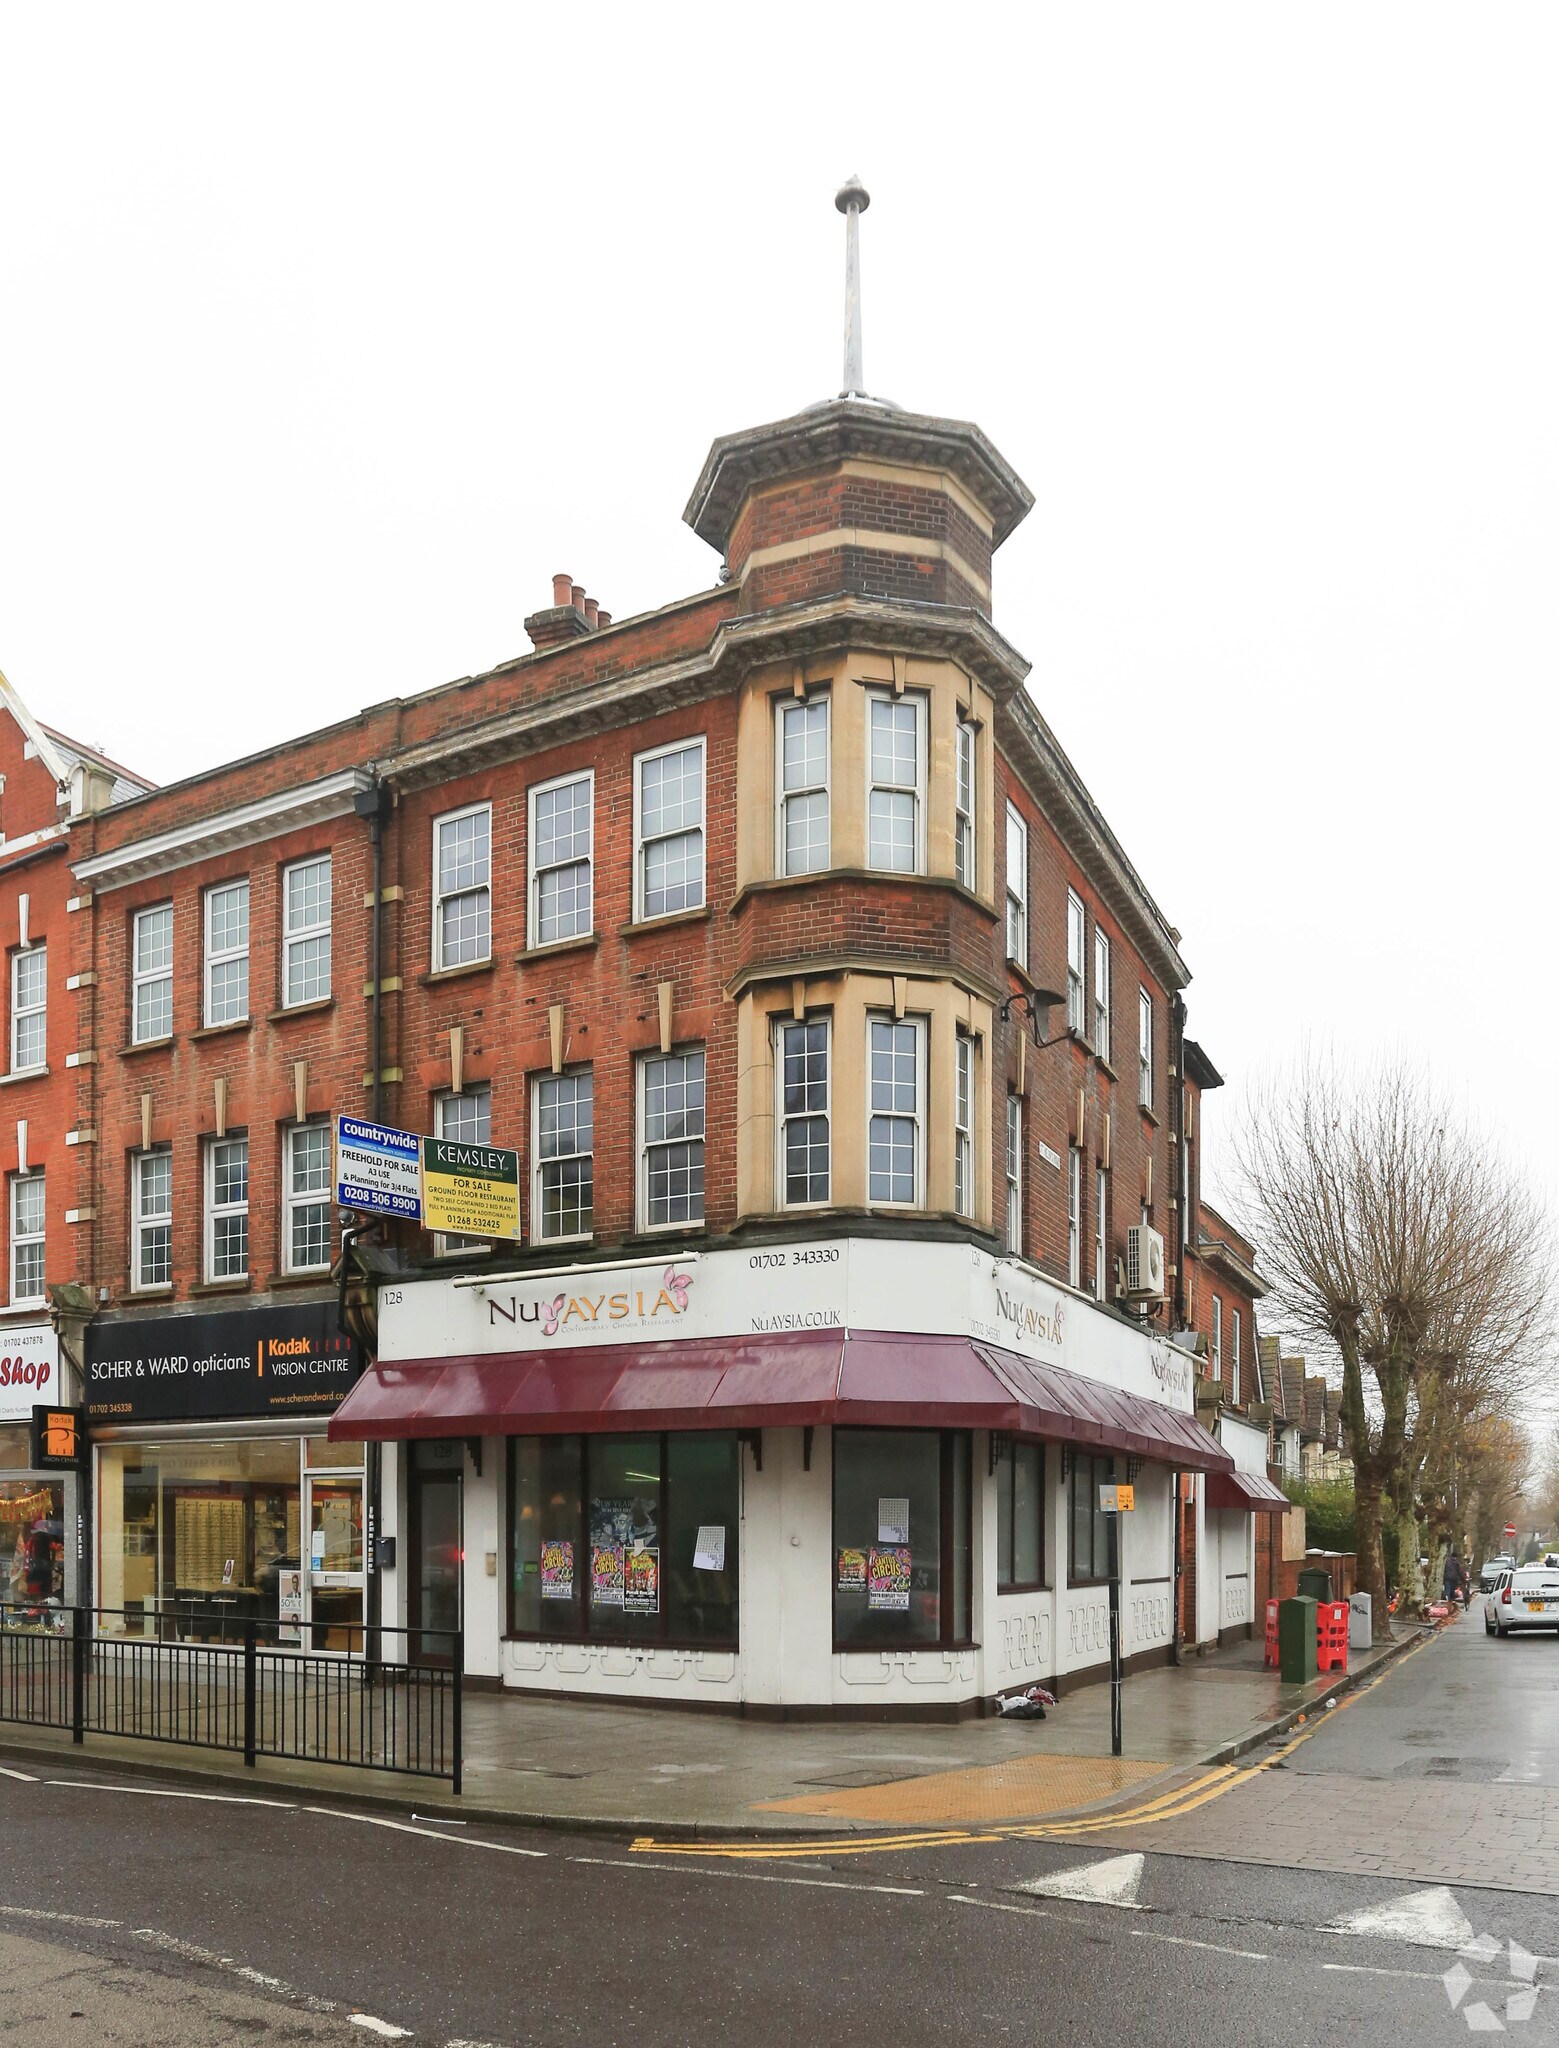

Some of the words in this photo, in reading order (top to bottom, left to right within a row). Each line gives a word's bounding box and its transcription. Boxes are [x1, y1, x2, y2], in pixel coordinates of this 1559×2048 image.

[344, 1123, 417, 1149] countrywide
[342, 1150, 382, 1166] FREEHOLD
[384, 1160, 399, 1170] FOR
[401, 1163, 419, 1174] SALE
[437, 1145, 505, 1170] KEMSLEY
[368, 1168, 376, 1176] A3
[378, 1171, 390, 1179] USE
[350, 1174, 379, 1188] Planning
[380, 1181, 390, 1189] for
[402, 1185, 417, 1195] Flats
[453, 1179, 470, 1188] FOR
[473, 1181, 491, 1191] SALE
[344, 1186, 369, 1202] 0208
[371, 1192, 390, 1206] 506
[392, 1197, 416, 1211] 9900
[428, 1186, 456, 1195] GROUND
[458, 1190, 478, 1198] FLOOR
[480, 1193, 516, 1204] RESTAURANT
[440, 1205, 466, 1213] PLANNING
[478, 1210, 506, 1218] ADDITIONAL
[456, 1199, 484, 1208] CONTAINED
[447, 1215, 471, 1225] 01268
[473, 1218, 500, 1229] 532425
[452, 1225, 496, 1234] www.kemsley.com
[749, 1253, 786, 1269] 01702
[792, 1249, 840, 1265] 343330
[971, 1250, 981, 1267] 128
[385, 1291, 403, 1305] 128
[4, 1337, 21, 1348] 01702
[22, 1335, 44, 1346] 437878
[268, 1337, 311, 1356] Kodak
[0, 1356, 51, 1391] Shop
[91, 1359, 133, 1380] SCHER
[135, 1359, 145, 1376] &
[148, 1356, 189, 1376] WARD
[192, 1352, 251, 1377] opticians
[272, 1361, 307, 1376] VISION
[309, 1358, 349, 1374] CENTRE
[89, 1404, 108, 1414] 01702
[109, 1402, 132, 1413] 345338
[49, 1415, 73, 1424] Kodak
[544, 1555, 565, 1571] CIRCUS
[595, 1560, 618, 1574] CIRCUS
[872, 1563, 901, 1579] CIRCUS
